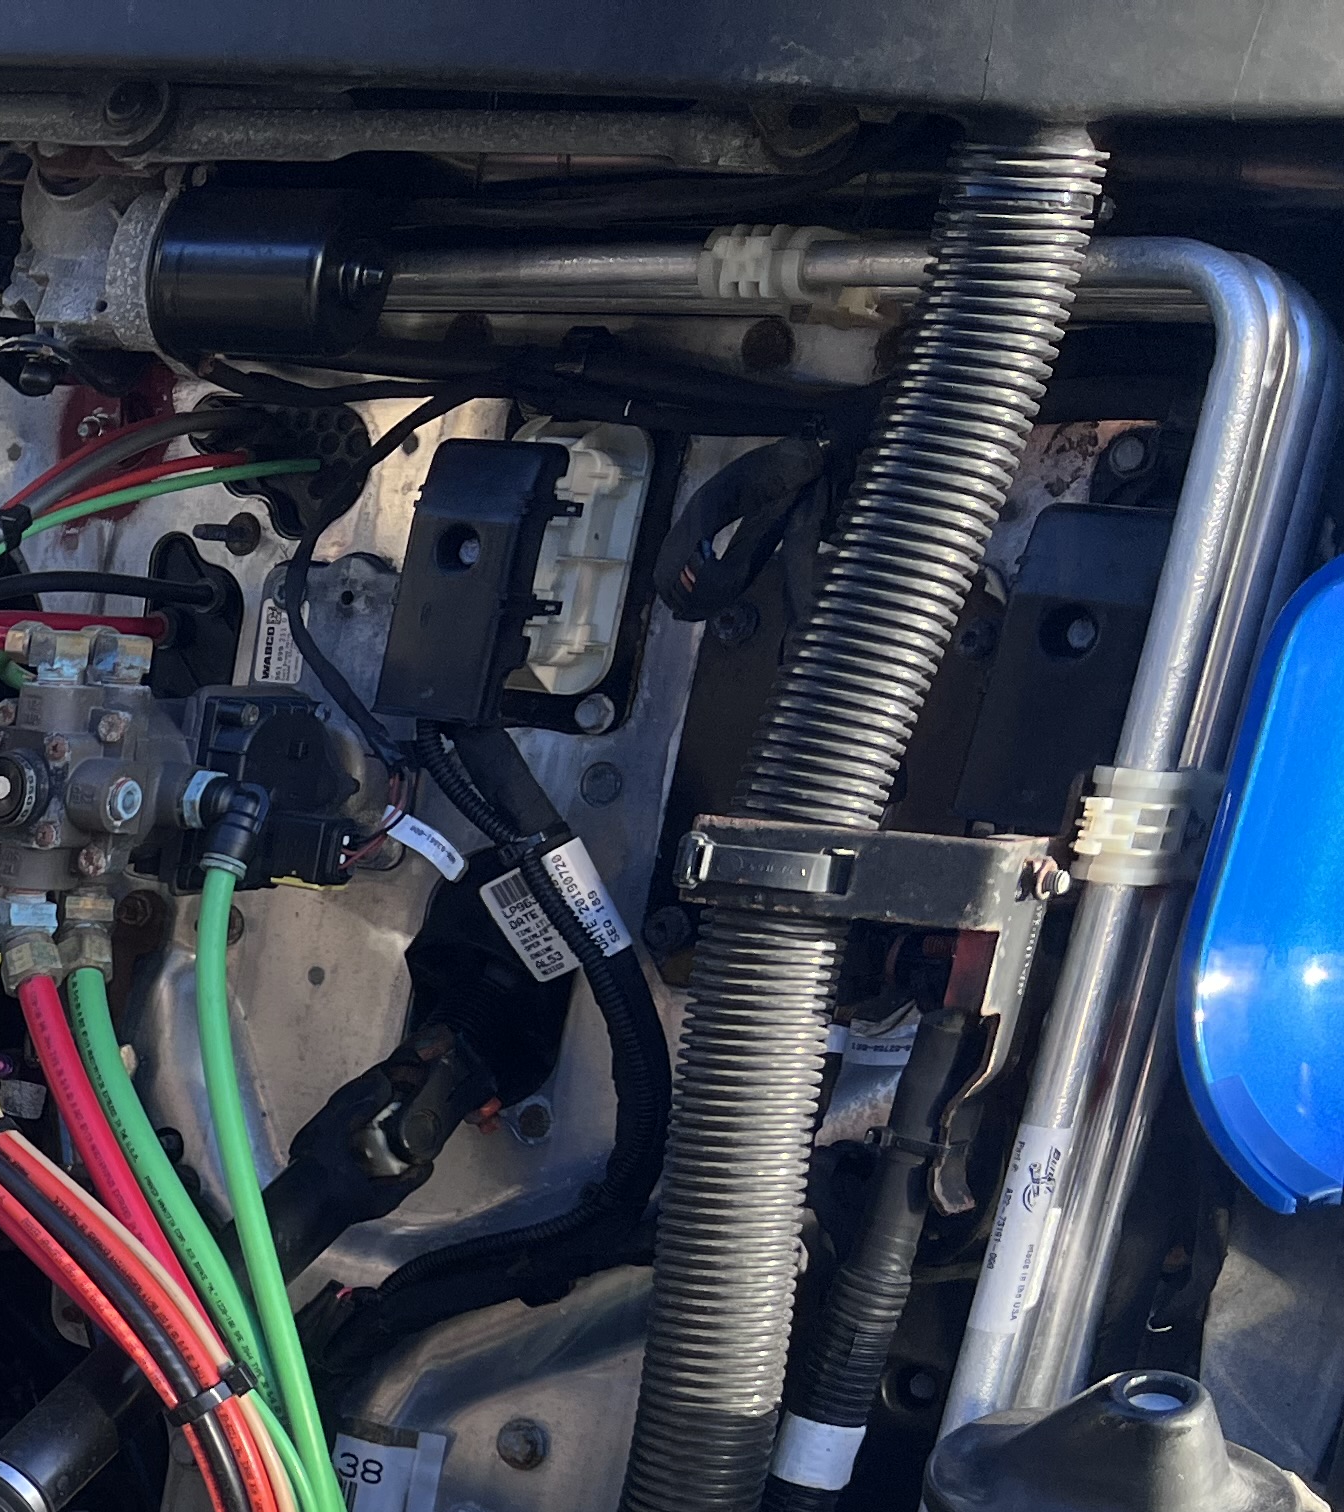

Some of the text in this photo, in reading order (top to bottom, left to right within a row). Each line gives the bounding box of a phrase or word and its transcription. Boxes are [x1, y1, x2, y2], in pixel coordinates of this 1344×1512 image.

[262, 626, 275, 680] WABCO
[1009, 1302, 1021, 1321] USA
[338, 1451, 384, 1486] 38
